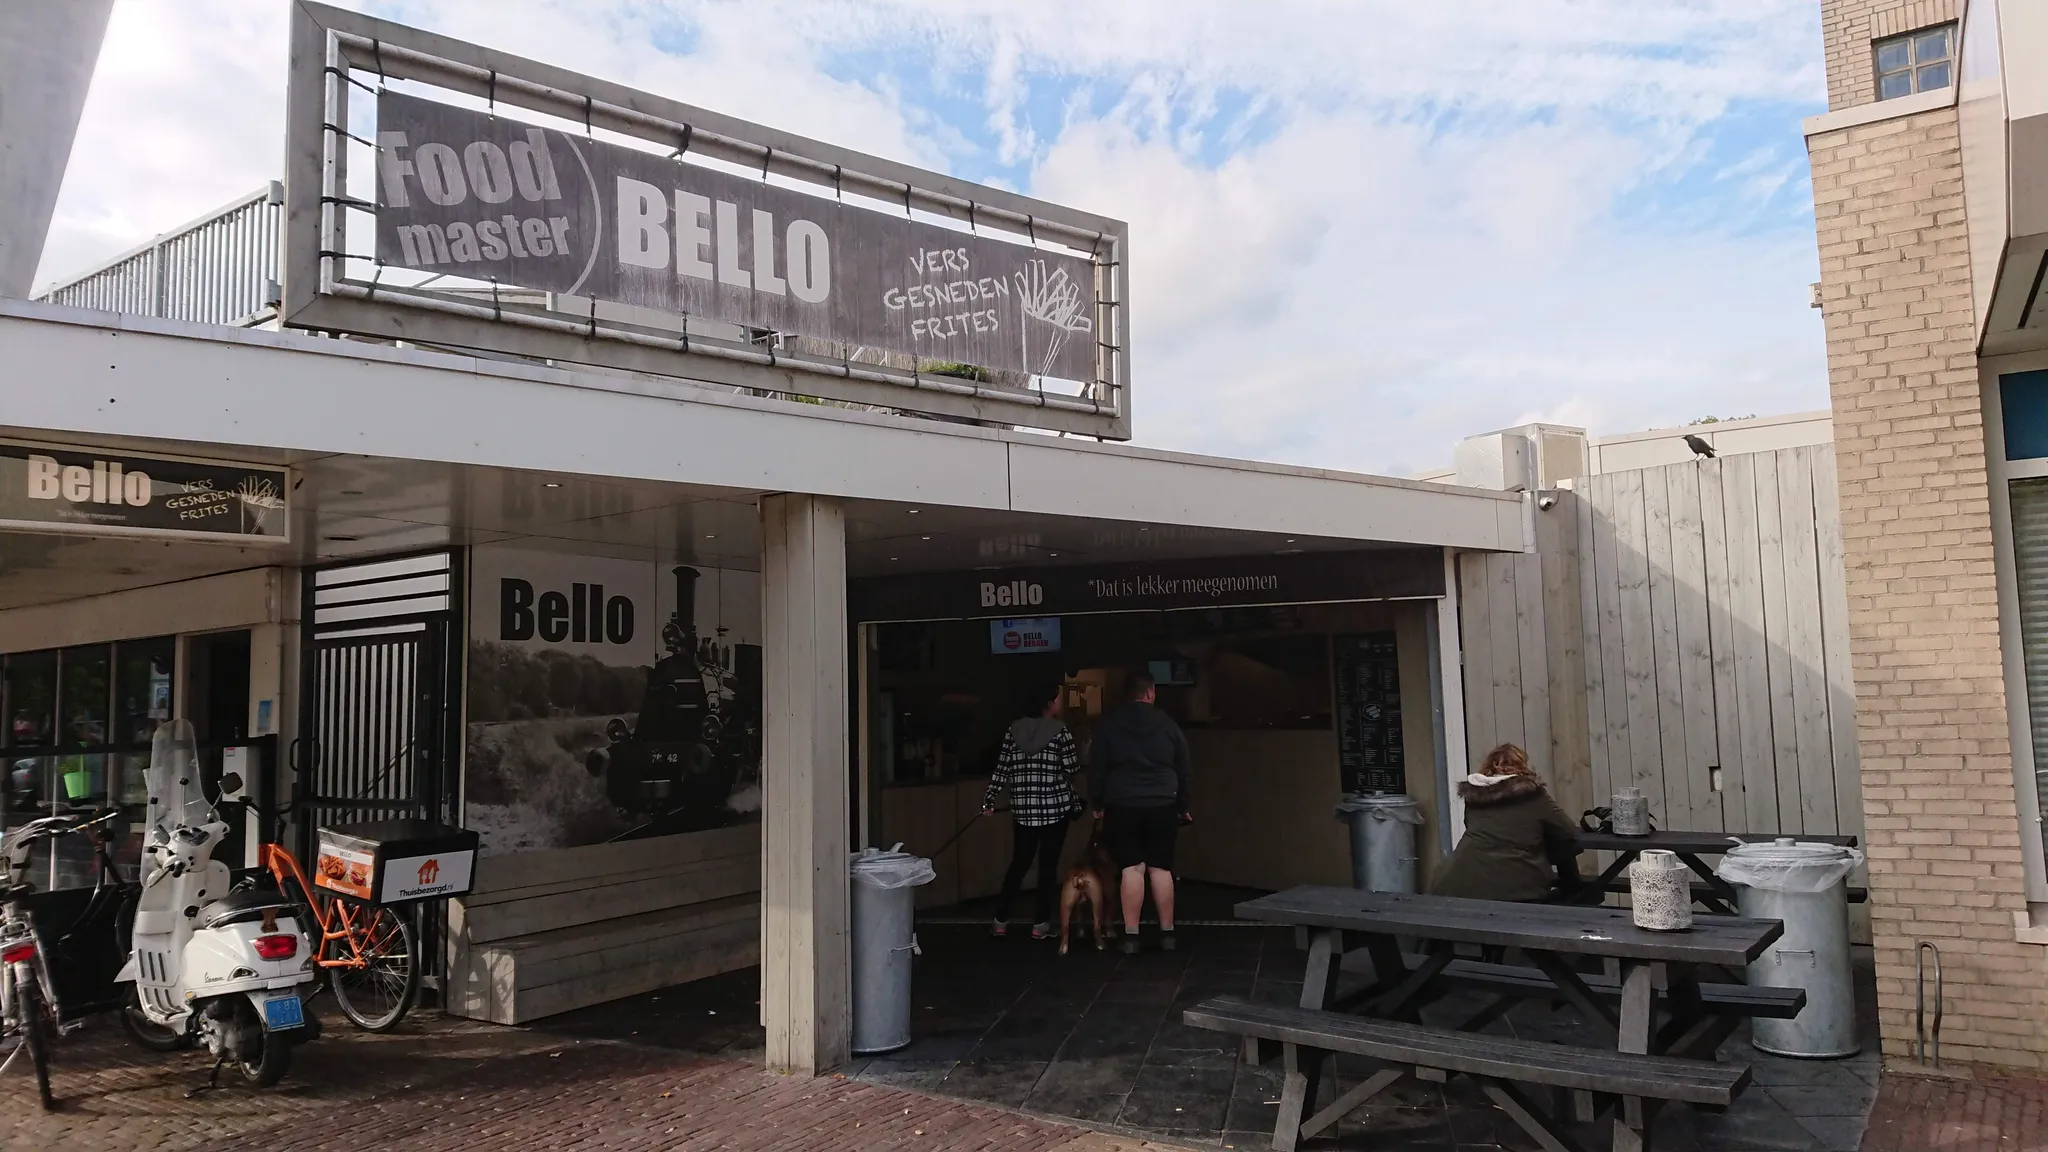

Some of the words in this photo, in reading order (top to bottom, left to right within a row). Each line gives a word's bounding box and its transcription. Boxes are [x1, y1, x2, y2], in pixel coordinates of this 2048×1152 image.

[377, 128, 562, 208] Food
[397, 213, 571, 266] master
[616, 176, 830, 304] BELLO
[910, 247, 970, 275] VERS
[883, 276, 1009, 310] GESNEDEN
[909, 309, 1000, 341] FRITES
[28, 454, 151, 507] Bello
[180, 479, 213, 493] VERS
[166, 489, 236, 509] GESNEDEN
[179, 504, 229, 521] FRITES
[980, 580, 1043, 607] Bello
[1122, 578, 1133, 597] is
[1136, 575, 1180, 596] lekker
[1182, 574, 1279, 597] meegenomen
[500, 577, 635, 645] Bello
[1023, 632, 1042, 640] BELLO
[399, 882, 454, 898] Thuisbezorgd.nl
